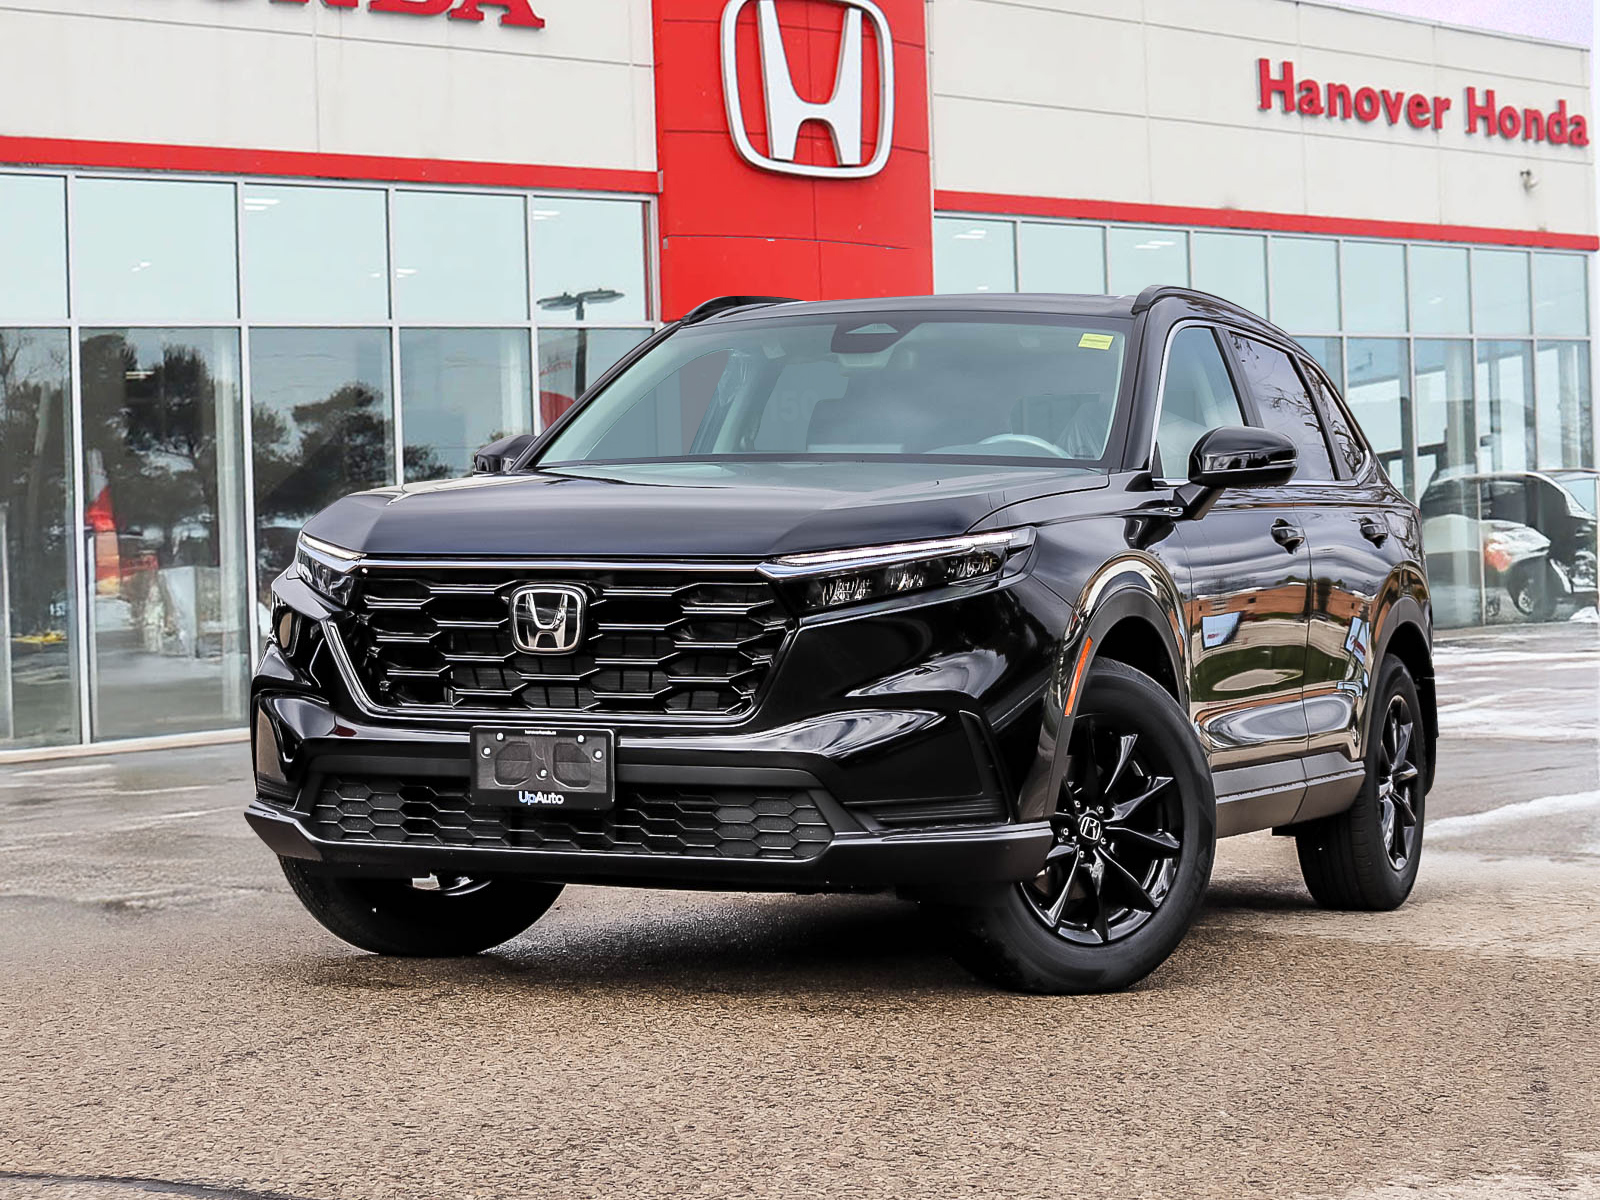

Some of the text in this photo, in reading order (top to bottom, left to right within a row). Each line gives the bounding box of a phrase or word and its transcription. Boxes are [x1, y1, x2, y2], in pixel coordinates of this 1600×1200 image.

[1257, 58, 1589, 147] Hanover Honda
[518, 790, 564, 806] UpAuto
